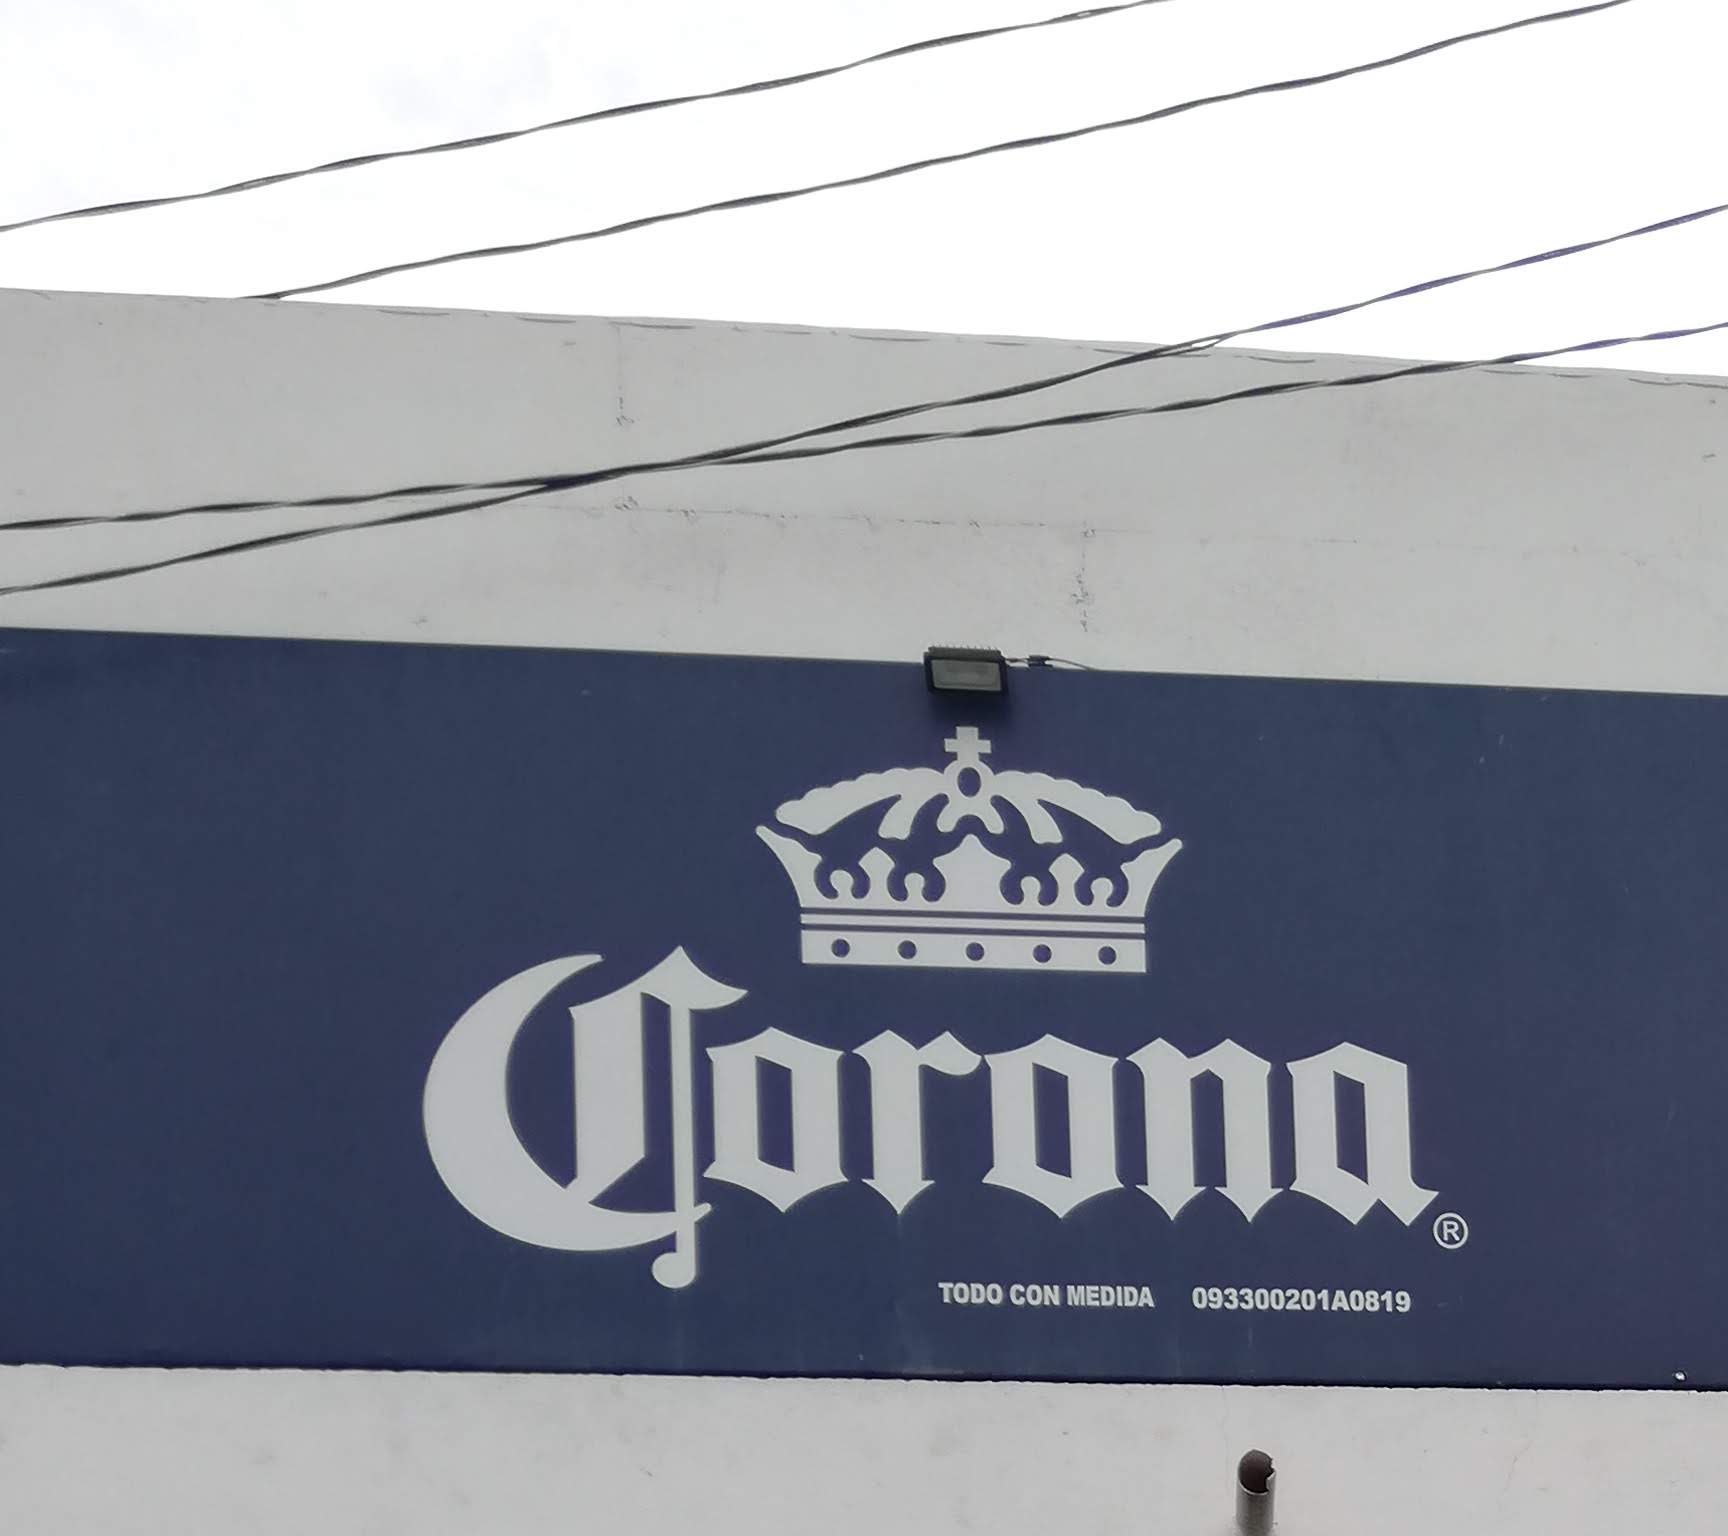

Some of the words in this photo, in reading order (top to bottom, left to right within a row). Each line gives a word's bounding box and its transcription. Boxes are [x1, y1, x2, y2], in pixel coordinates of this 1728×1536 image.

[422, 945, 1440, 1289] Corona
[938, 1282, 1002, 1305] TODO
[1009, 1284, 1060, 1306] CON
[1066, 1285, 1155, 1308] MEDIDA
[1191, 1287, 1411, 1312] 093300201A0819
